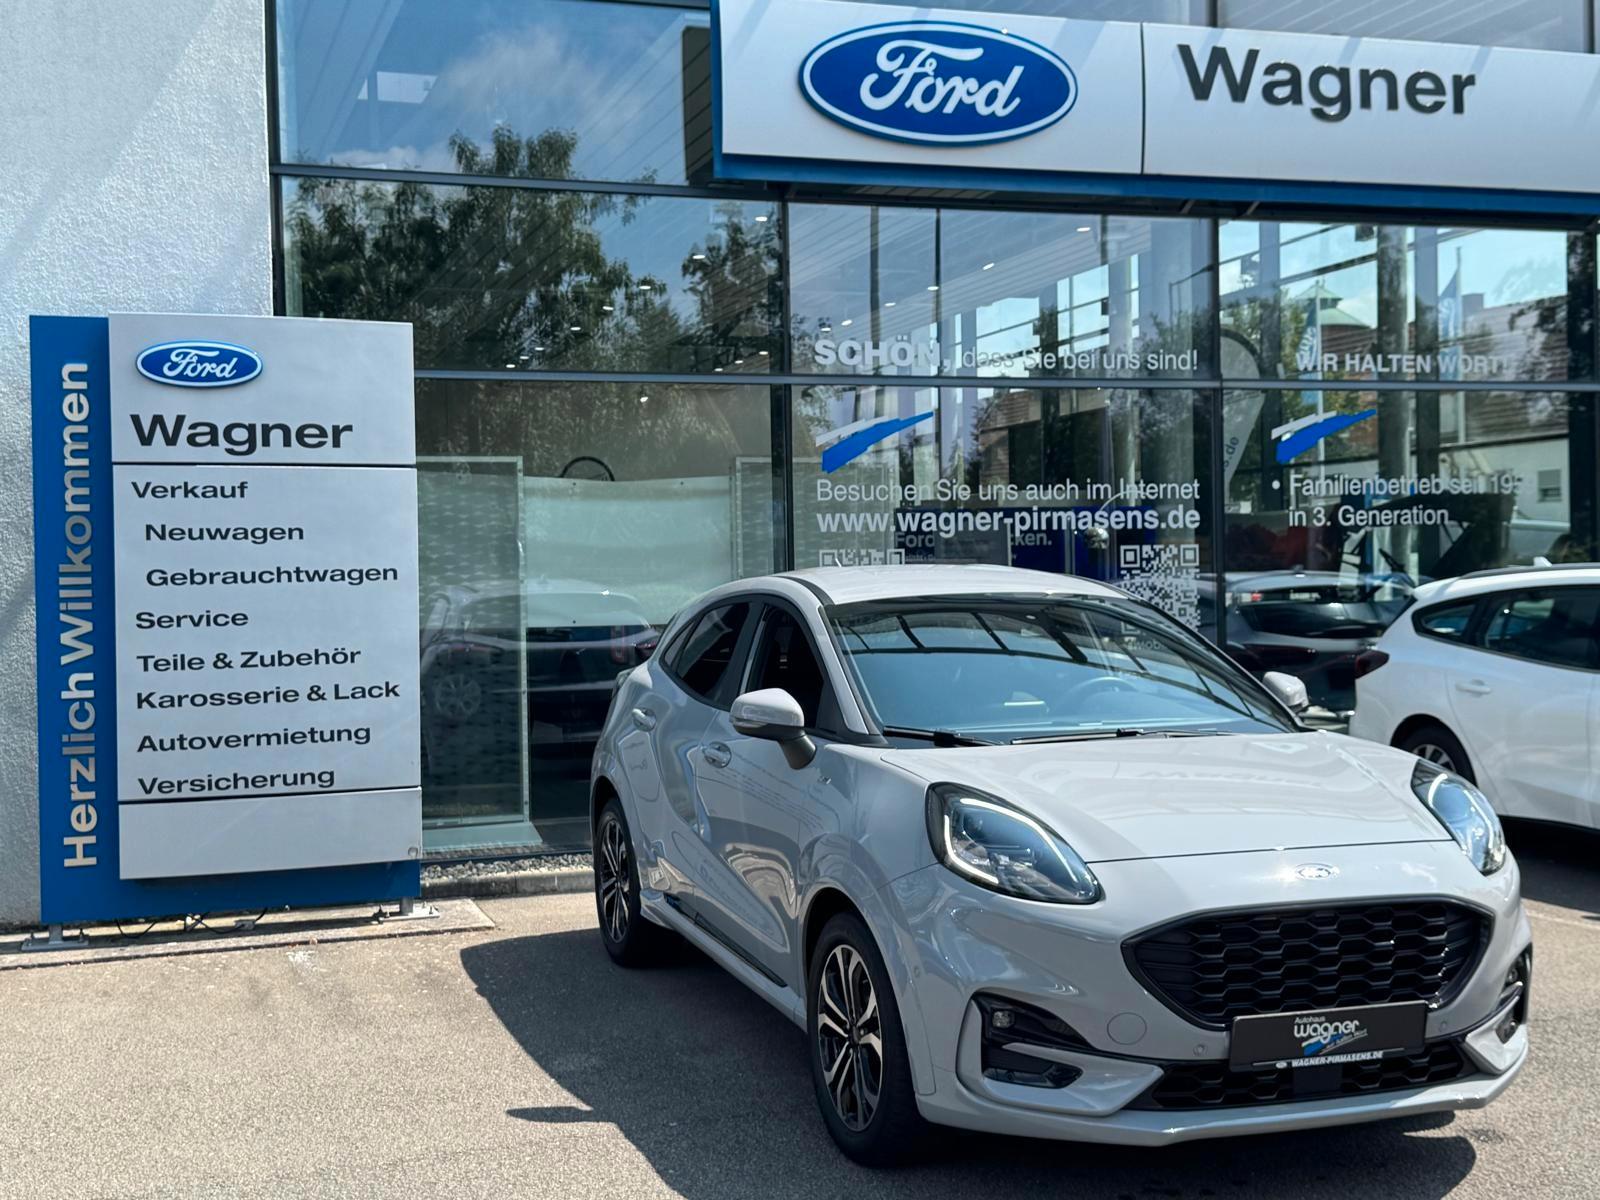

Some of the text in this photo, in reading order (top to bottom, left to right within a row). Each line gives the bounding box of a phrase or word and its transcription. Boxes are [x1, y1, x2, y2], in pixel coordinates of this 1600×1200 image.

[859, 39, 1025, 117] Ford
[1177, 44, 1476, 123] Wagner
[162, 348, 237, 379] Ford
[814, 335, 1198, 372] SCHÖN, dass Sie bei uns sind!
[1296, 352, 1338, 372] WIR
[1344, 352, 1432, 374] HALTEN
[129, 414, 353, 456] Wagner
[131, 481, 249, 499] Verkauf
[816, 476, 1200, 502] Besuchen Sie uns auch im Internet
[1289, 473, 1442, 496] Familienbetrieb
[816, 504, 1201, 538] www.wagner-pirmasens.de
[1288, 505, 1449, 527] in 3. Generation
[145, 524, 304, 544] Neuwagen
[146, 567, 398, 586] Gebrauchtwagen
[59, 362, 98, 868] Herzlich Willkommen
[135, 610, 249, 629] Service
[136, 647, 361, 672] Teile & Zubehör
[136, 681, 400, 709] Karosserie & Lack
[137, 725, 371, 752] Autovermietung
[138, 769, 335, 795] Versicherung
[1291, 1051, 1384, 1067] WAGNER-PIRMASENS.DE
